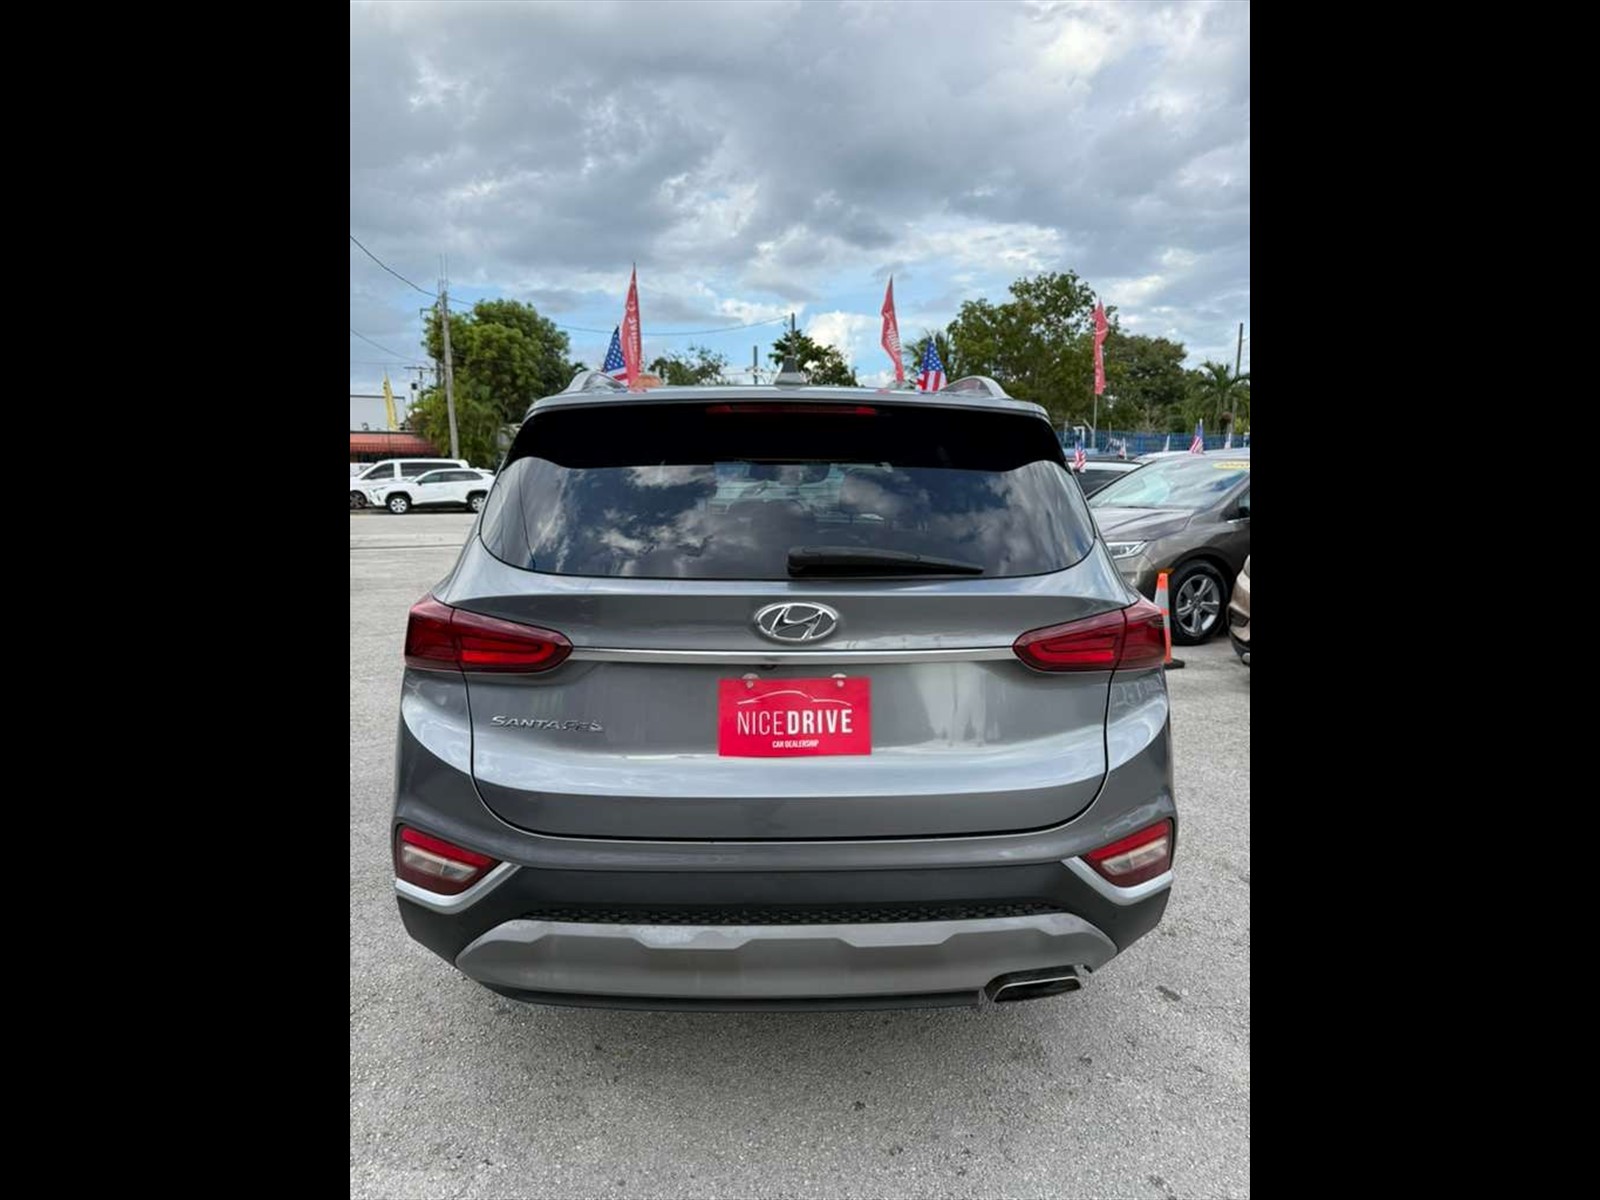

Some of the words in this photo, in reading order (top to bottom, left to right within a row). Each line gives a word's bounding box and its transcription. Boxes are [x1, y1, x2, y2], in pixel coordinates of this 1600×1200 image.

[491, 715, 560, 730] SANTA
[772, 740, 785, 748] CAR
[785, 739, 820, 748] DEALERSHIP
